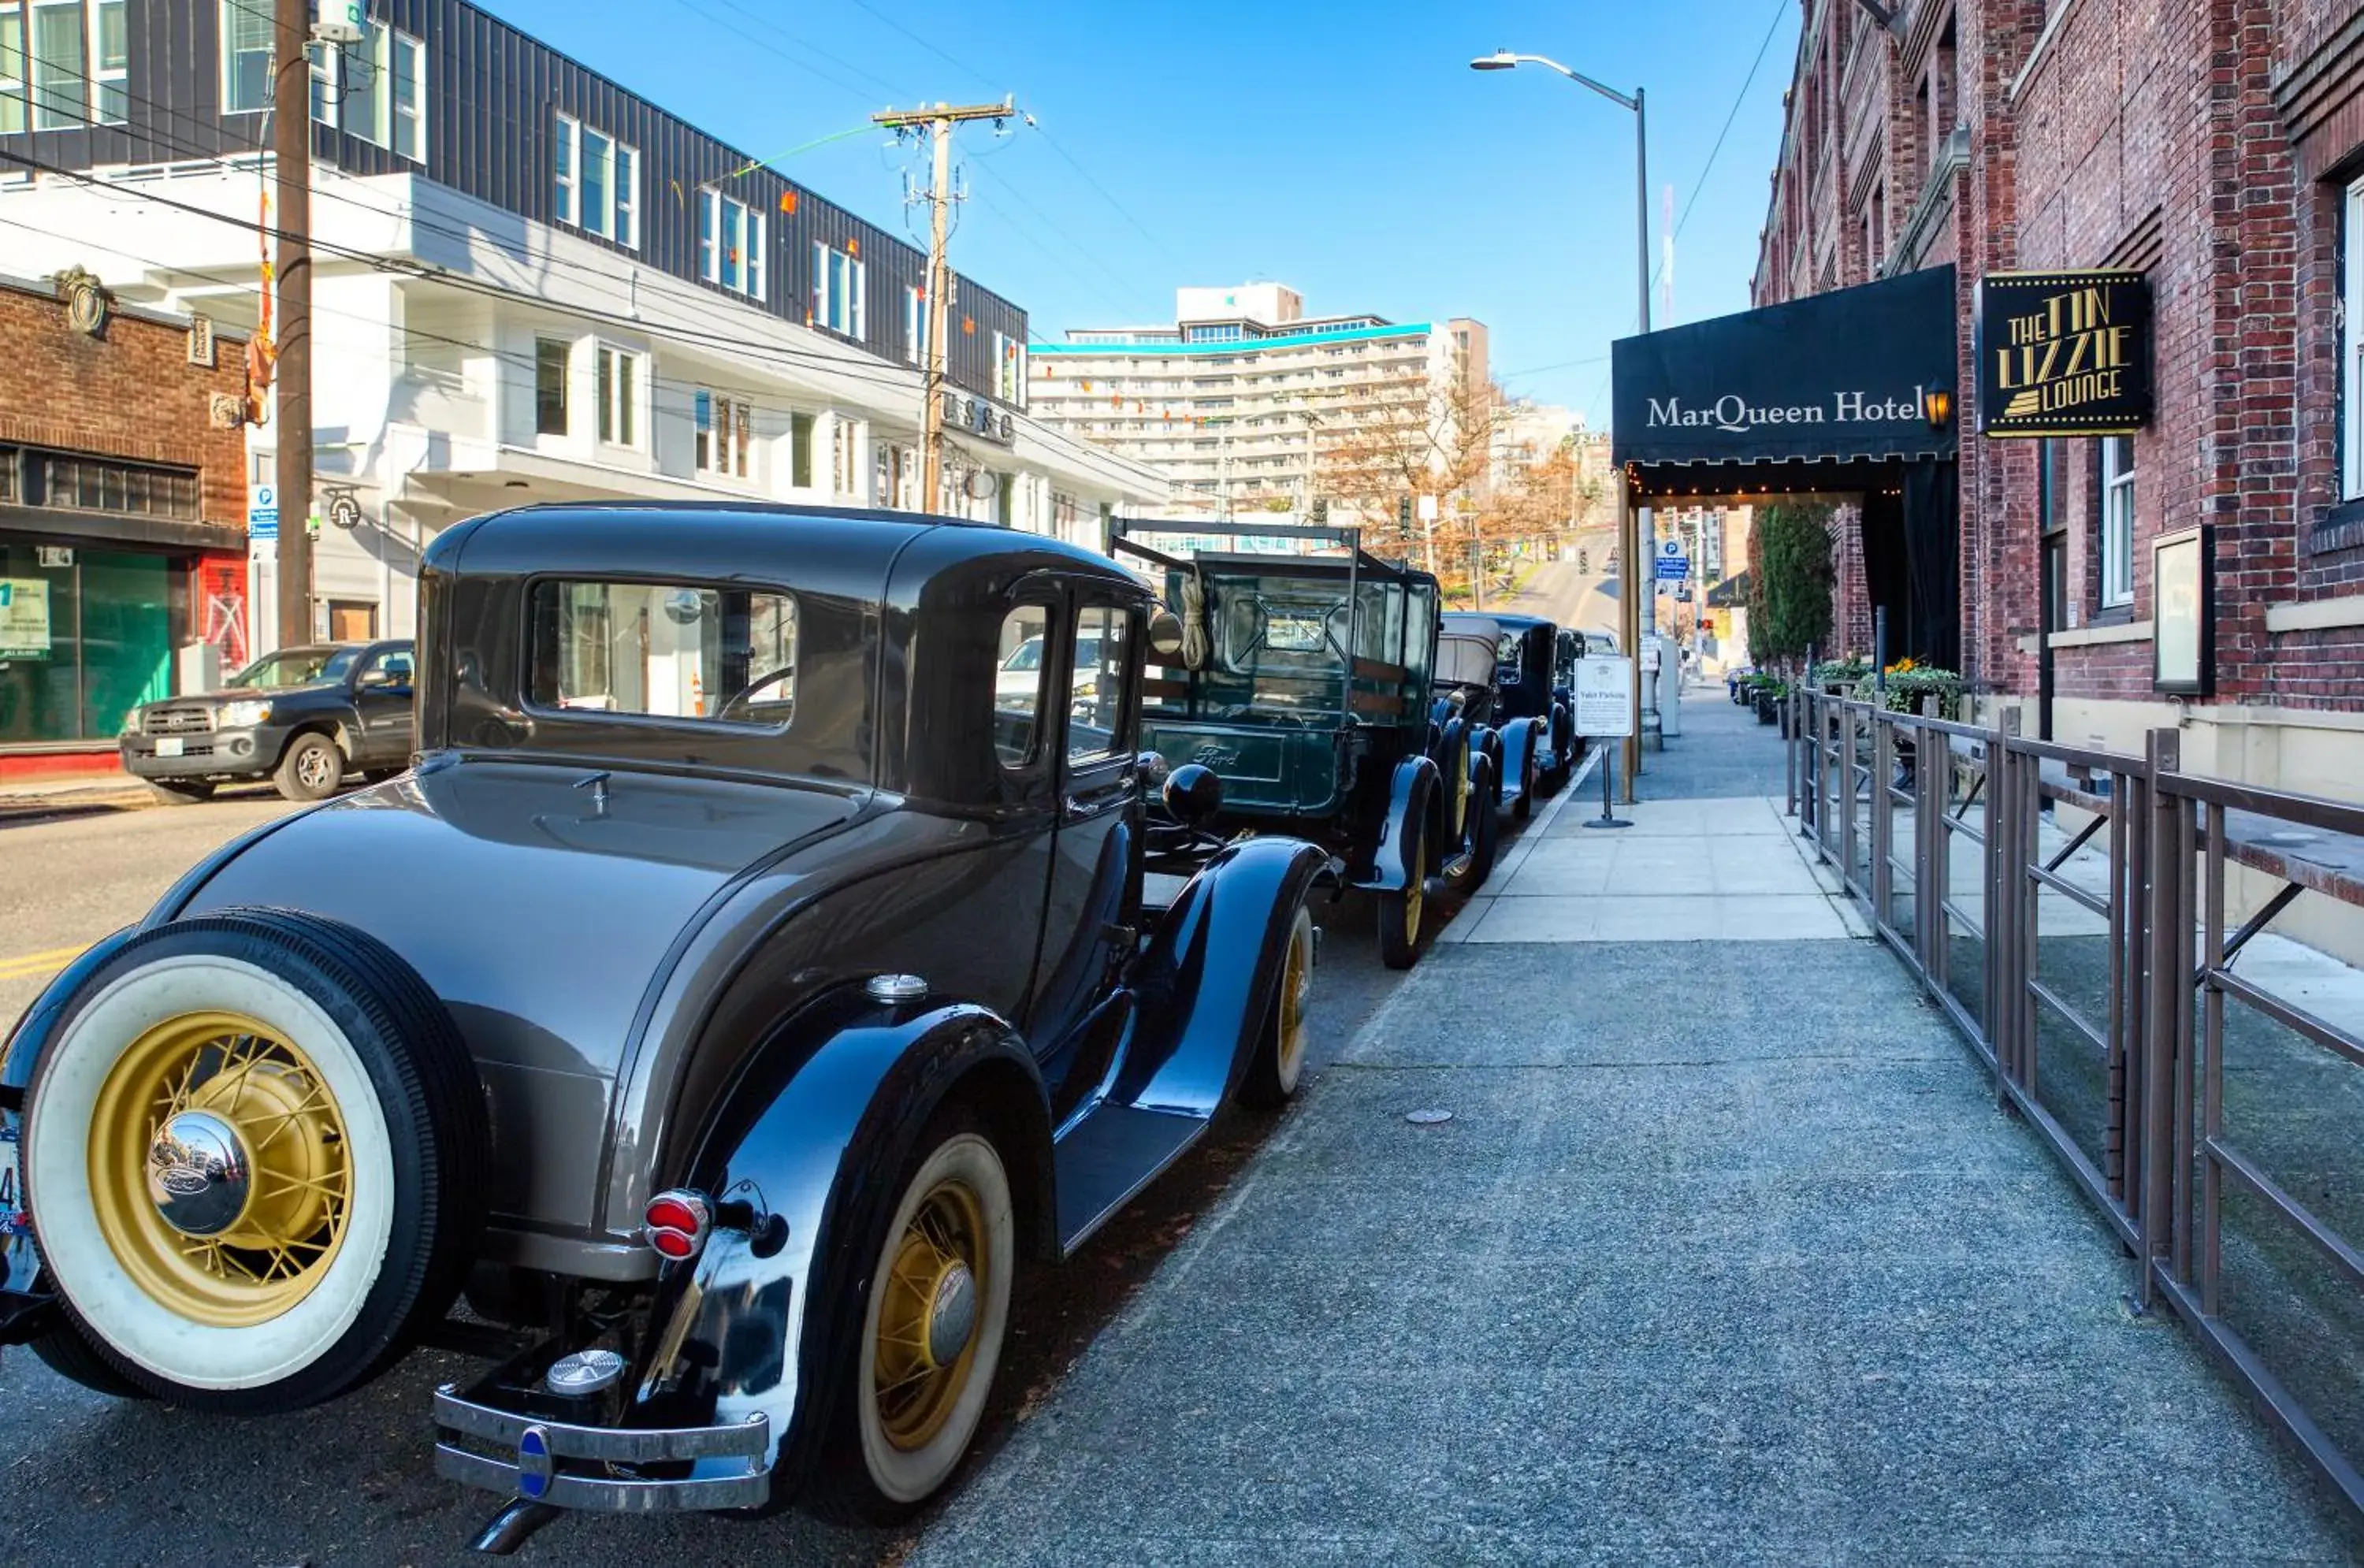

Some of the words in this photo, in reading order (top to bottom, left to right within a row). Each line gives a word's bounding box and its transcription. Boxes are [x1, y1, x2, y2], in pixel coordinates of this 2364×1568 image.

[2007, 313, 2046, 346] THE
[2042, 284, 2109, 338] TIN
[1996, 325, 2132, 388] LIZZIE
[1645, 395, 1826, 433] MarQueen
[1834, 385, 1927, 422] Hotel
[2042, 370, 2122, 412] LOUNGE
[338, 507, 351, 524] R
[1192, 743, 1241, 767] Ford
